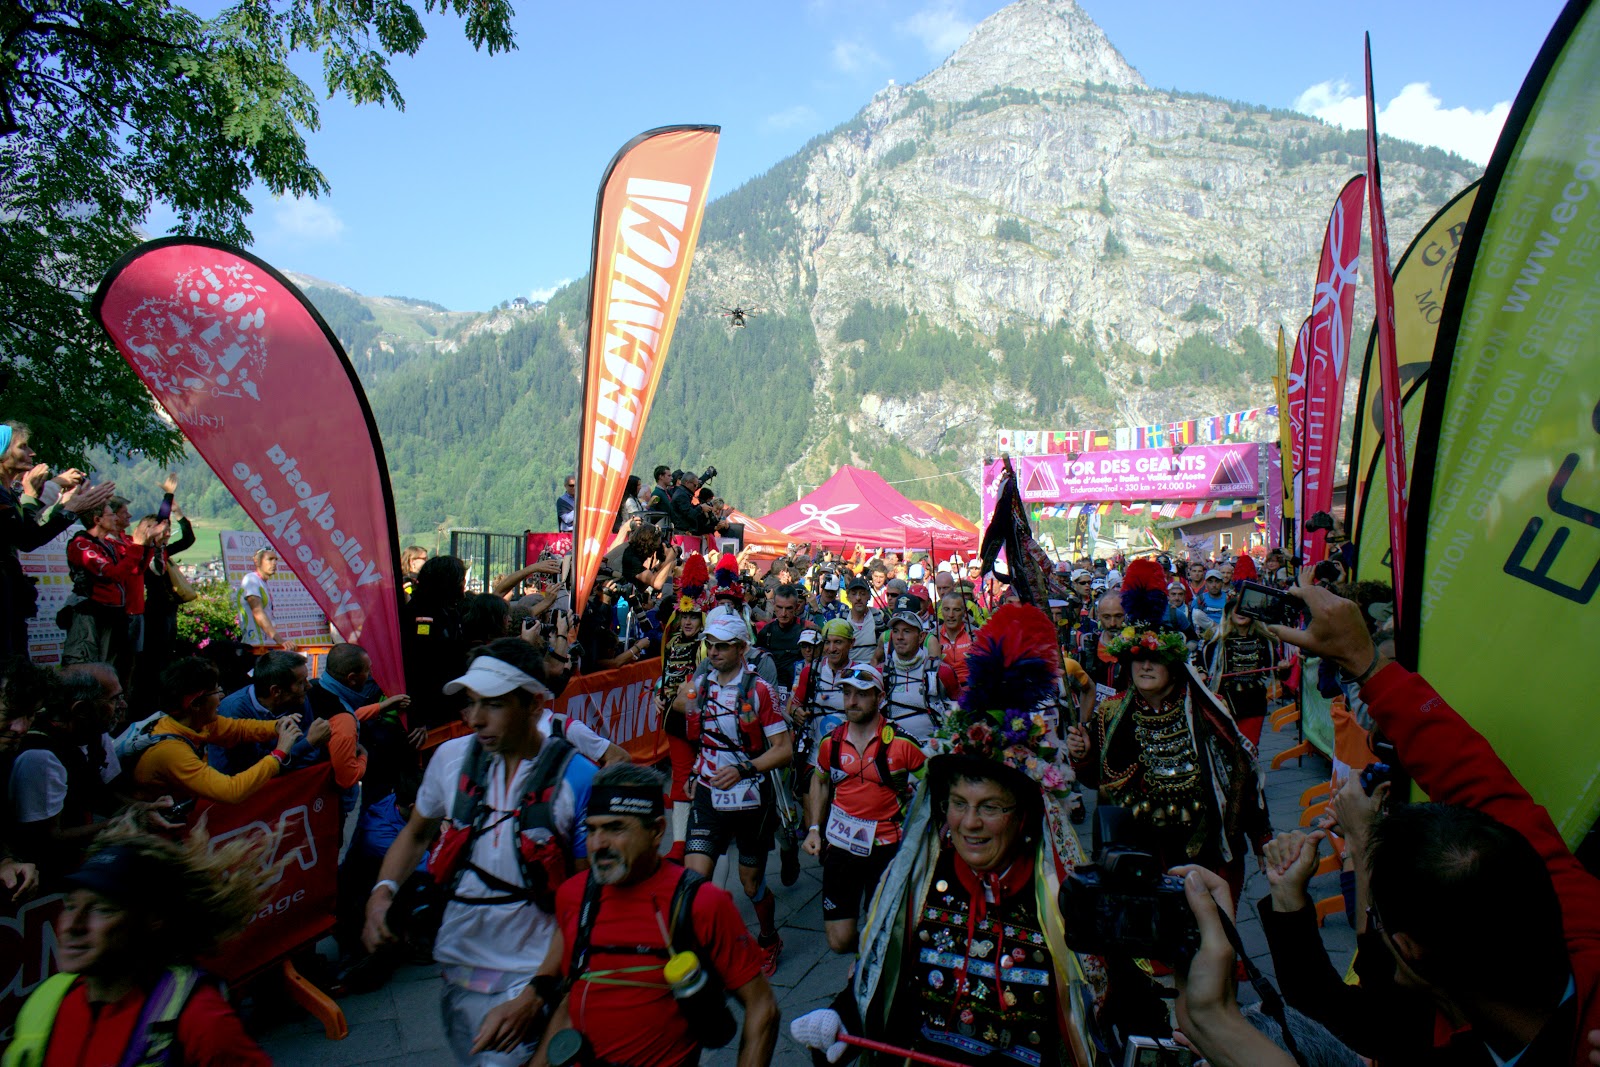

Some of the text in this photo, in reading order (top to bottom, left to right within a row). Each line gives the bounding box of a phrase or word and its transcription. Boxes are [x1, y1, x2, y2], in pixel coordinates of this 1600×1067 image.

[590, 177, 692, 481] TECNICA
[1063, 455, 1206, 477] TOR DES GEANTS
[1124, 484, 1139, 492] 330
[1140, 483, 1151, 491] km
[1157, 482, 1184, 490] 24.000
[240, 535, 256, 547] TOR
[715, 793, 737, 805] 751
[830, 818, 851, 838] 794
